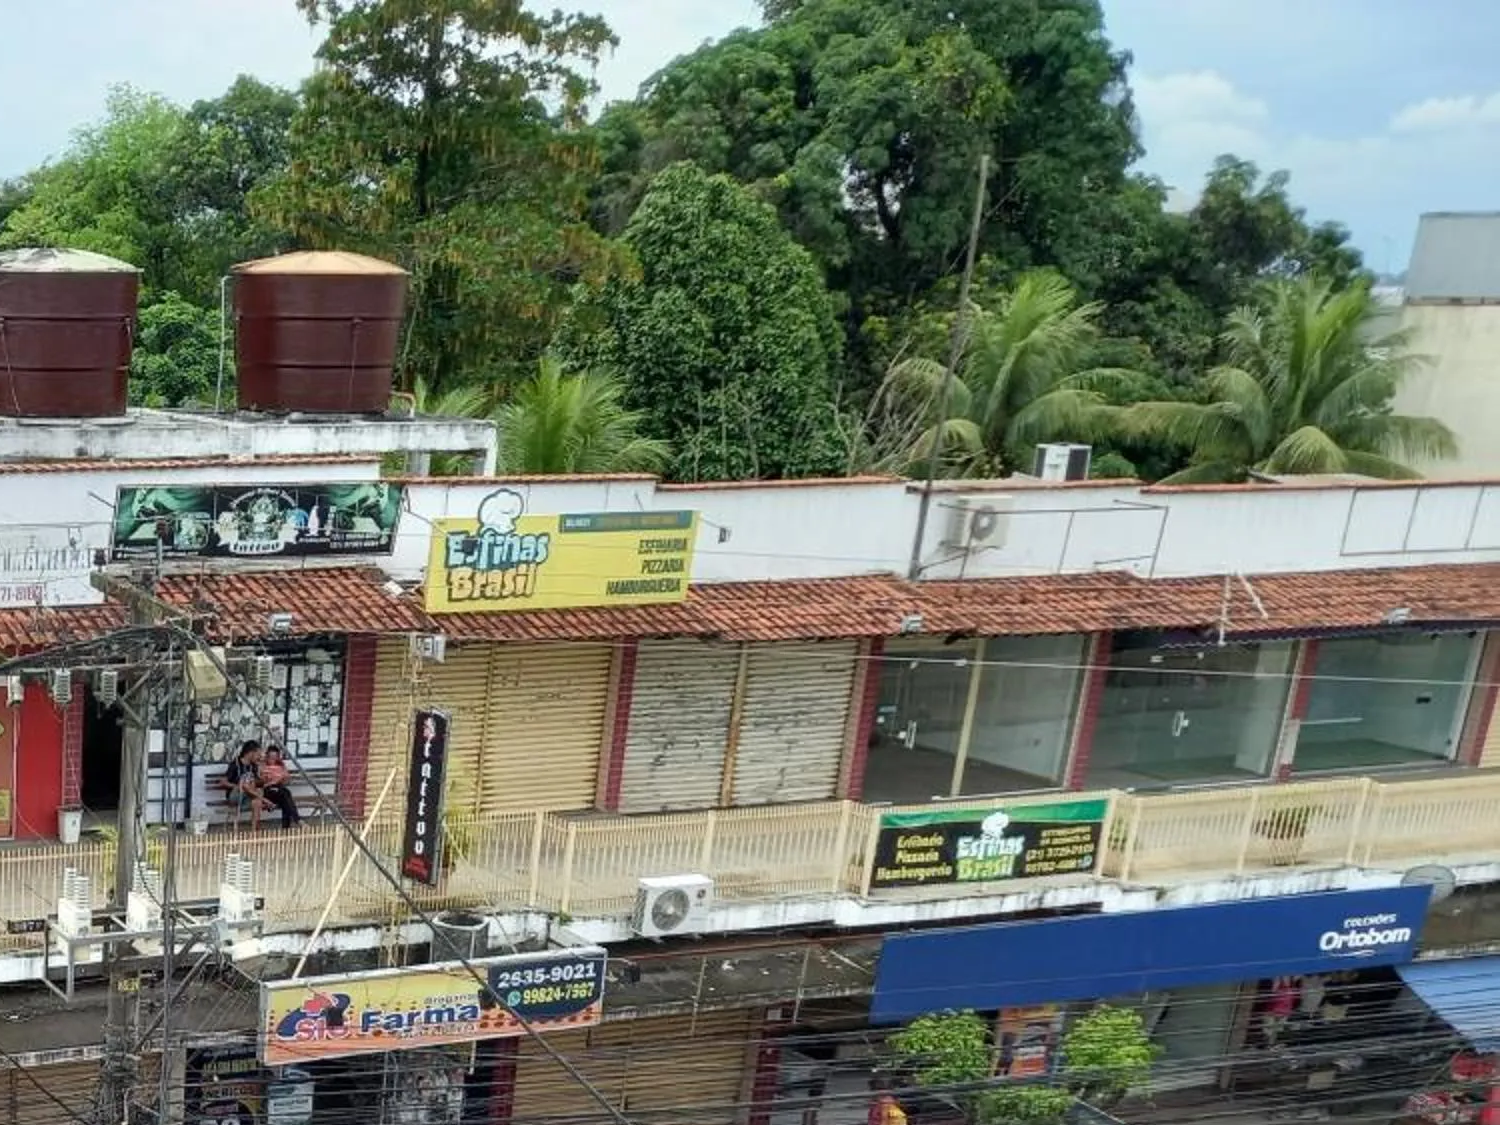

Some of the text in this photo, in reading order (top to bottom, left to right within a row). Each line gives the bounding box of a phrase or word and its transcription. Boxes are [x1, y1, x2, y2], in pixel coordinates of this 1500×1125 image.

[448, 565, 538, 602] Brasil
[1319, 928, 1412, 951] Ortobom
[361, 1003, 480, 1033] Farma
